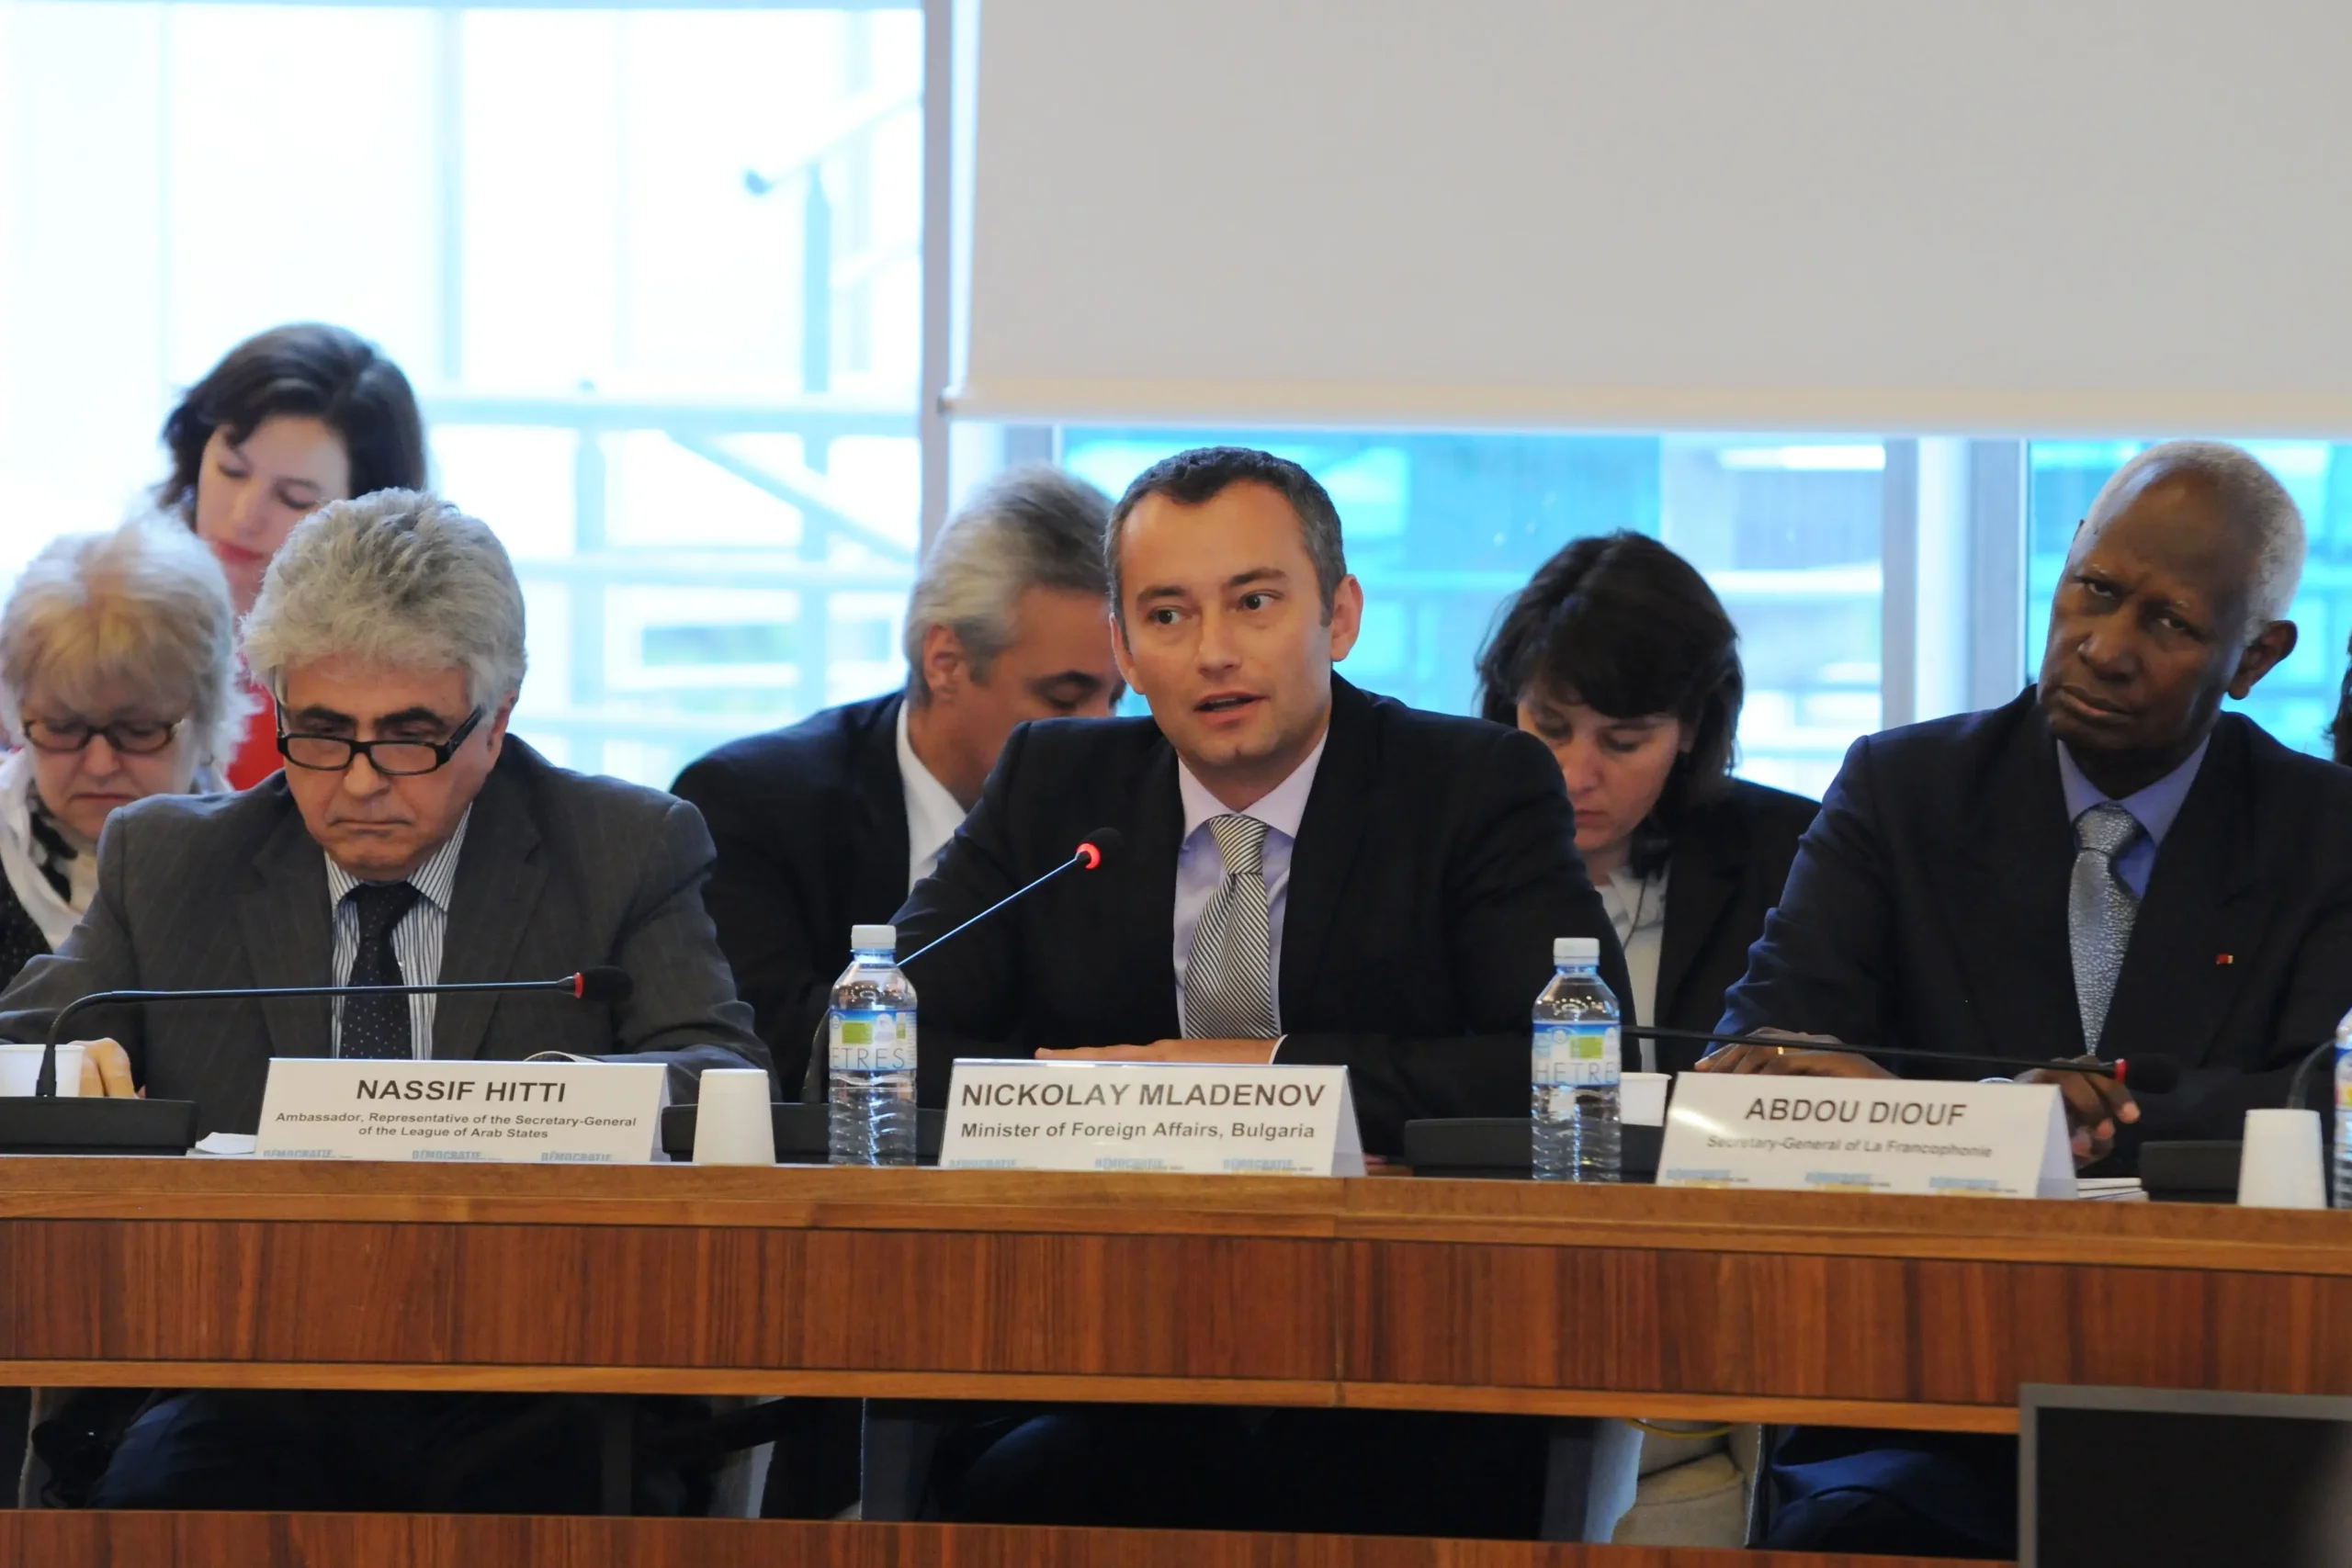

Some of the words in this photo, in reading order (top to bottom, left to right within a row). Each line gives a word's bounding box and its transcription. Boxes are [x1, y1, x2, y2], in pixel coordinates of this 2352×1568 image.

[356, 1079, 476, 1100] NASSIF
[484, 1081, 567, 1103] HITTI
[961, 1084, 1131, 1107] NICKOLAY
[1138, 1084, 1327, 1107] MLADENOV
[275, 1112, 365, 1123] Ambassador,
[368, 1112, 469, 1124] Representative
[472, 1114, 488, 1124] of
[490, 1114, 512, 1125] the
[514, 1114, 638, 1128] Secretary-General
[1745, 1098, 1860, 1122] ABDOU
[1868, 1101, 1968, 1126] DIOUF
[357, 1126, 373, 1136] of
[375, 1126, 397, 1136] the
[401, 1126, 450, 1139] League
[453, 1127, 468, 1137] of
[470, 1128, 503, 1138] Arab
[506, 1128, 548, 1139] States
[960, 1122, 1041, 1138] Minister
[1046, 1122, 1067, 1137] of
[1071, 1122, 1147, 1141] Foreign
[1152, 1122, 1225, 1140] Affairs,
[1231, 1122, 1316, 1142] Bulgaria
[1707, 1134, 1841, 1153] Secretary-General
[1844, 1138, 1861, 1152] of
[1863, 1139, 1883, 1153] La
[1885, 1139, 1994, 1158] Francophonie
